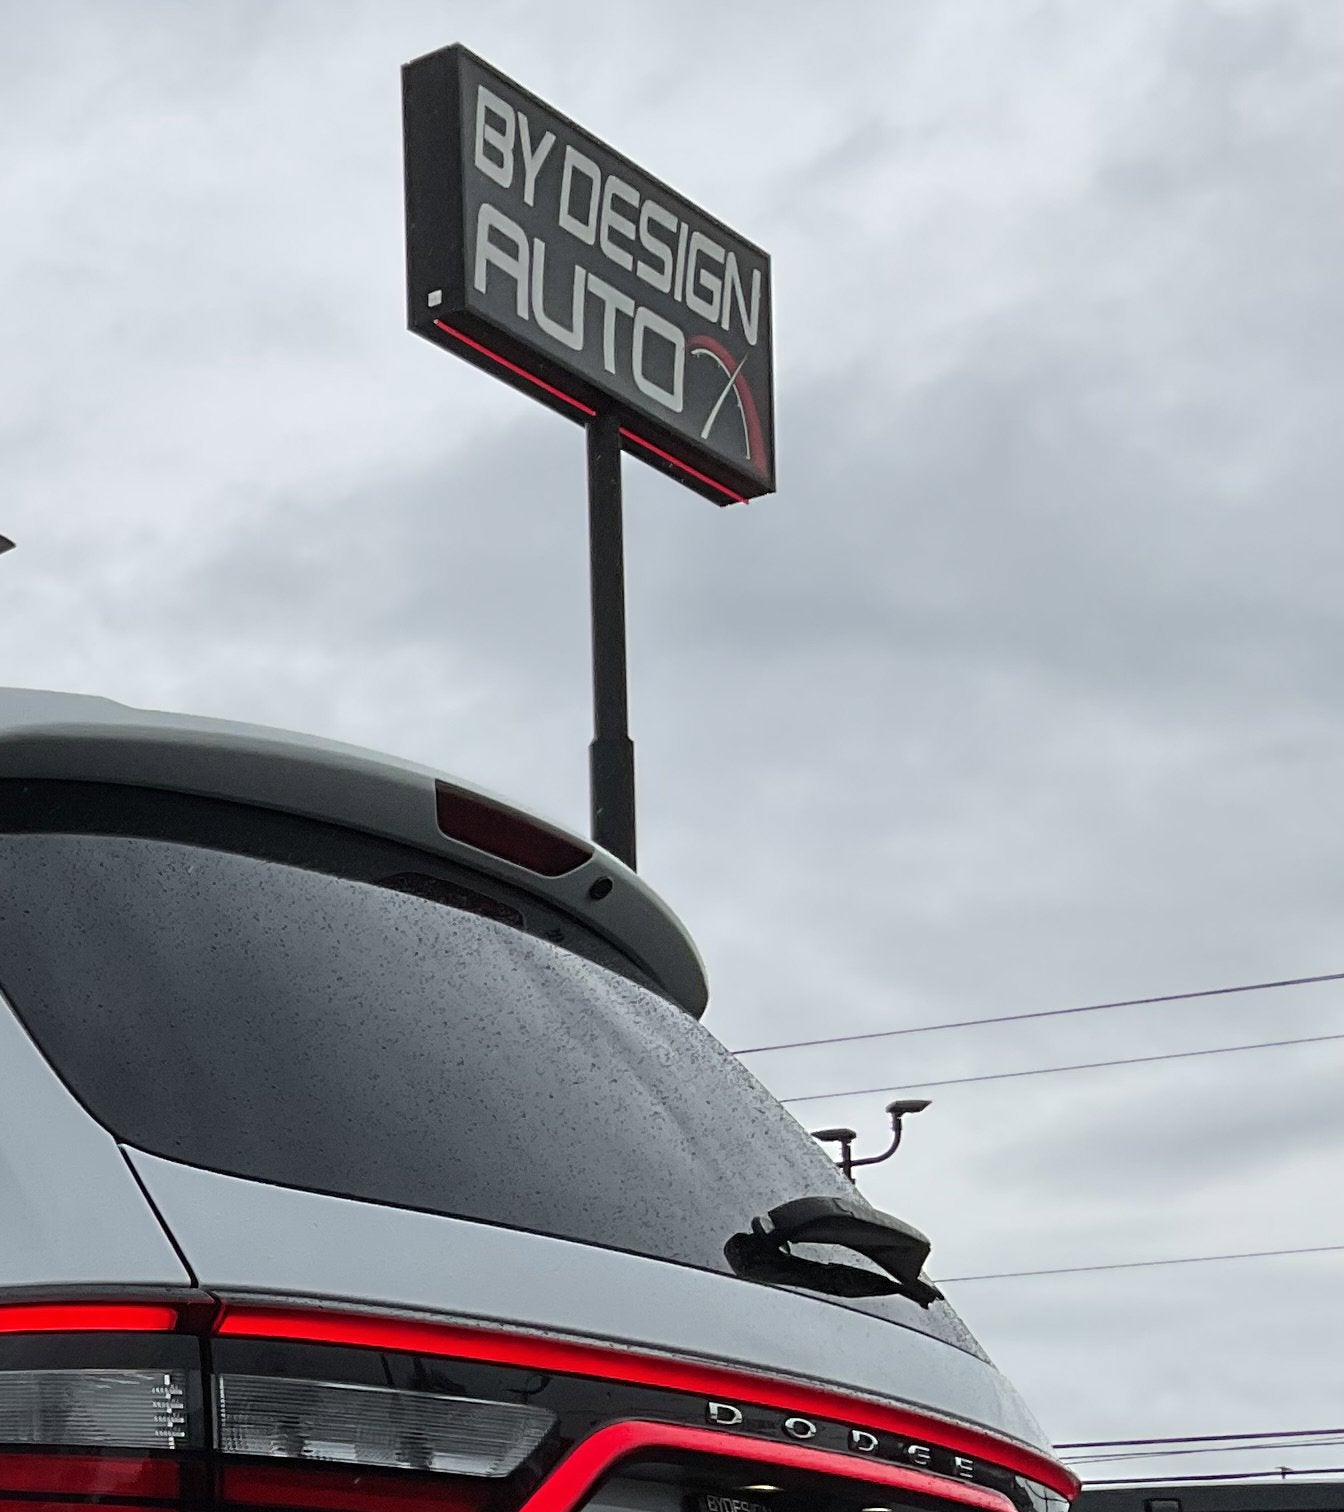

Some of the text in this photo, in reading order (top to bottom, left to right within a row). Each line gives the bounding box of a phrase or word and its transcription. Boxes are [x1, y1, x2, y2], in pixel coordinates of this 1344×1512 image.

[474, 84, 762, 347] BY DESIGN
[474, 202, 685, 414] AUTO
[706, 1401, 975, 1479] DODGE
